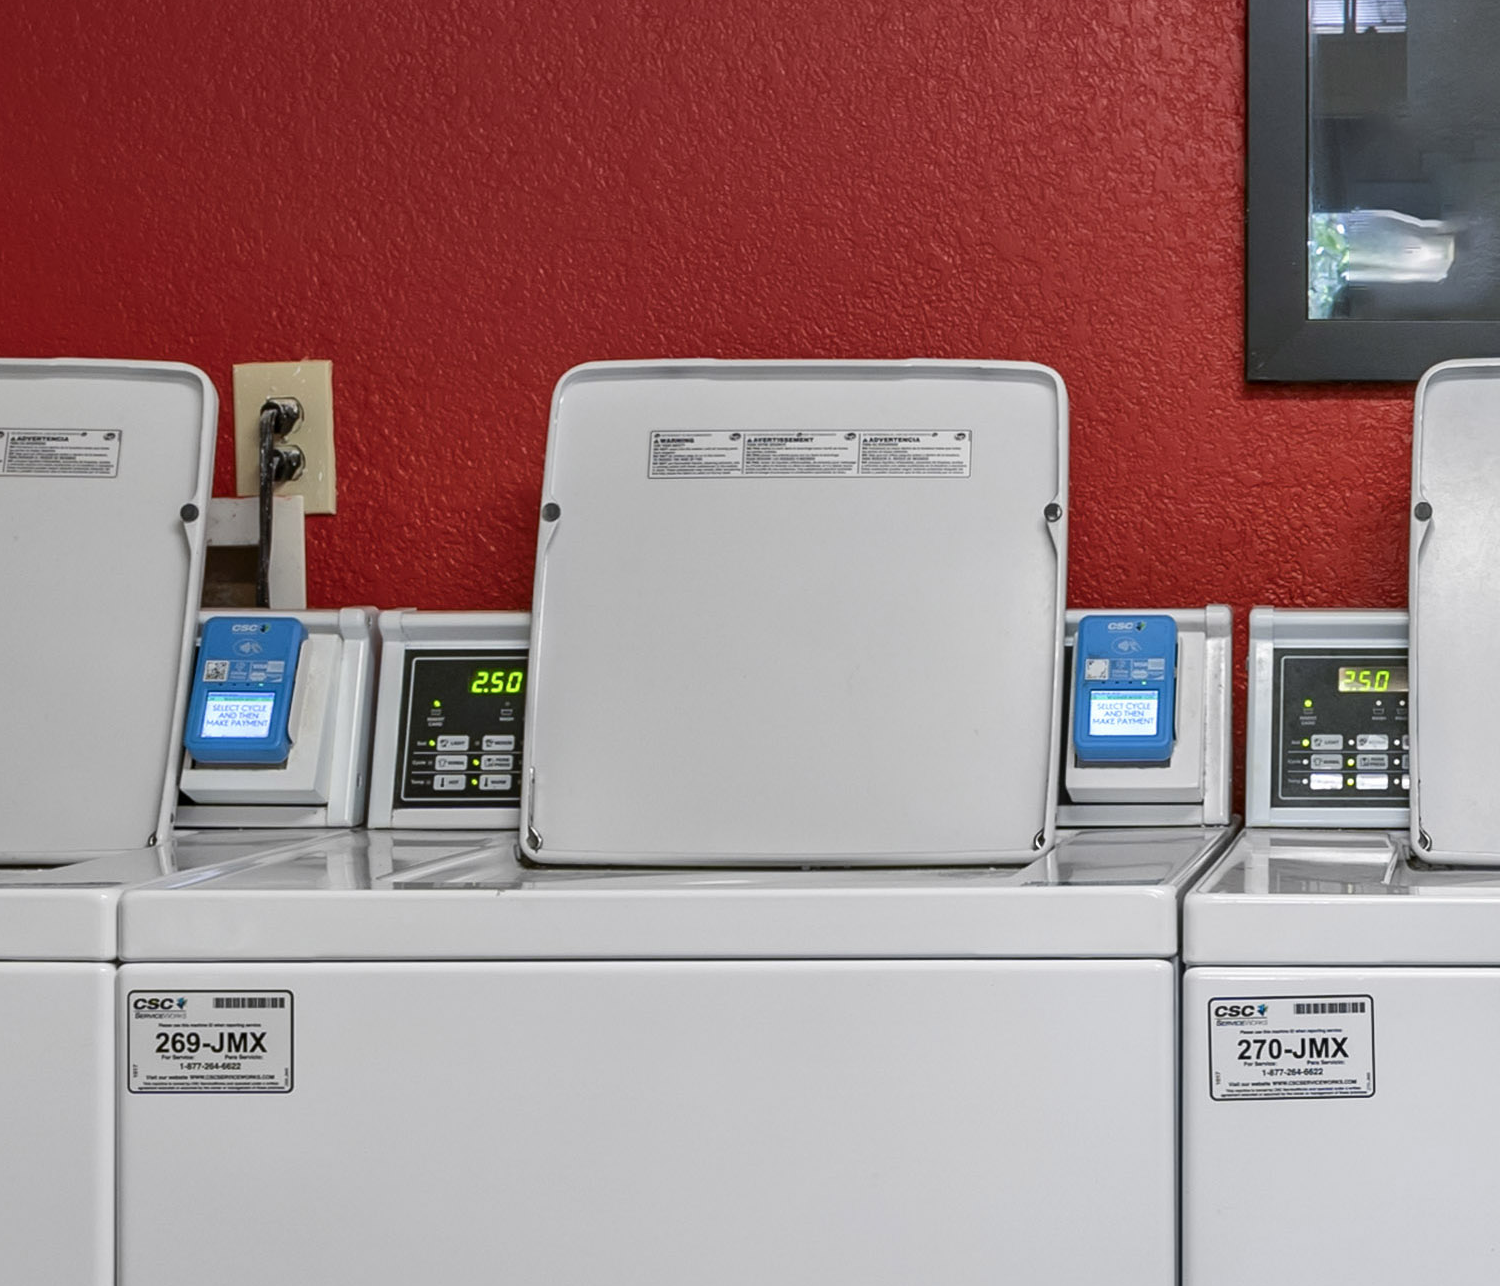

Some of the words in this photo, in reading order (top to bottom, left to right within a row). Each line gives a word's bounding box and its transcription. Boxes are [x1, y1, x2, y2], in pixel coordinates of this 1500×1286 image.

[232, 624, 258, 632] CSC
[471, 672, 523, 693] 2.50
[133, 997, 174, 1010] CSC
[1214, 1005, 1254, 1017] CSC
[156, 1032, 267, 1053] 269-JMX
[1238, 1037, 1349, 1060] 270-JMX
